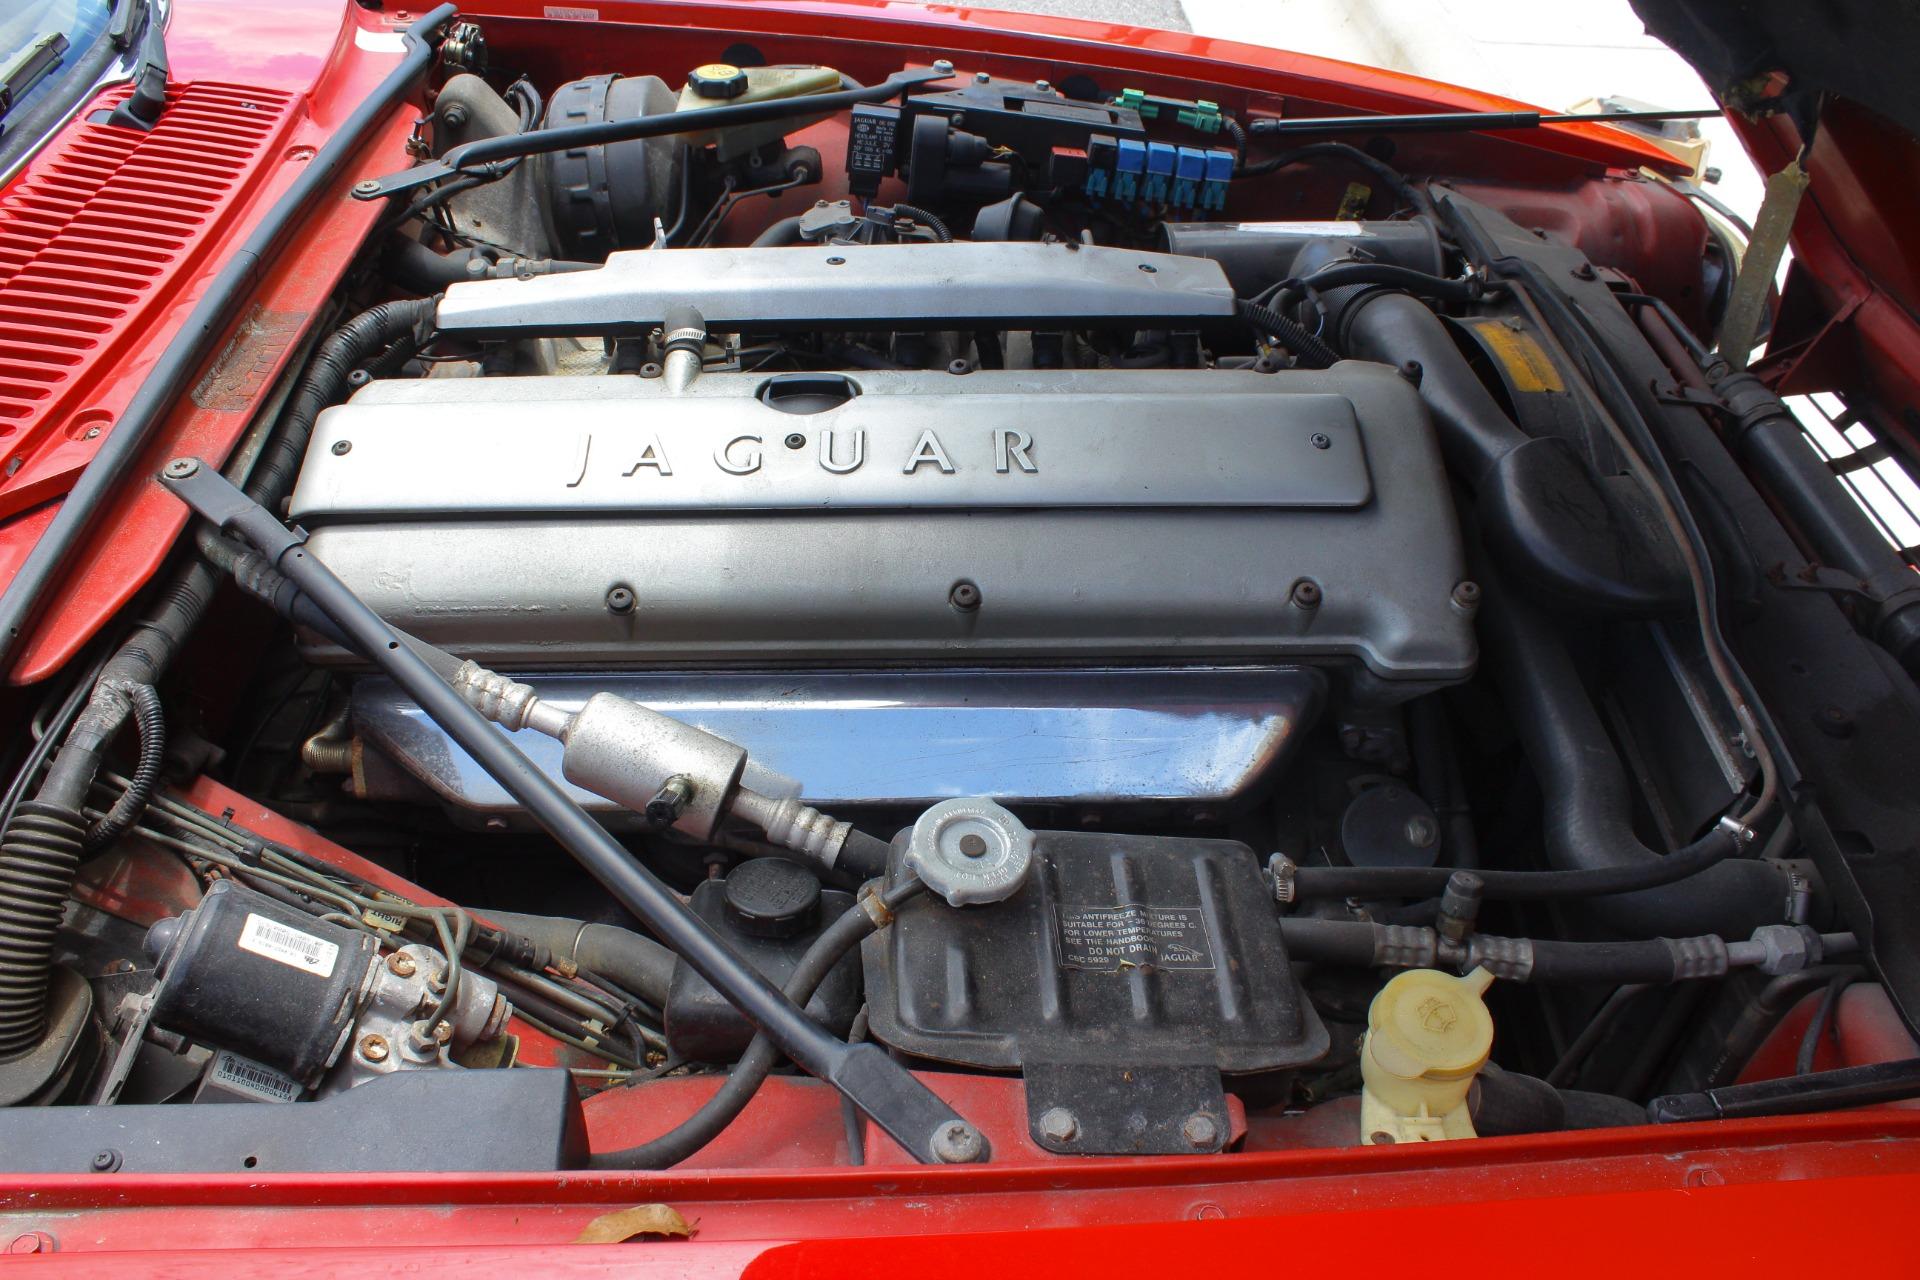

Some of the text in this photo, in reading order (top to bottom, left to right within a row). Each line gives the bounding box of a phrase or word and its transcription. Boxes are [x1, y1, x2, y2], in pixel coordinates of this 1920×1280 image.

[566, 427, 1038, 488] JAGUAR
[1082, 909, 1137, 920] ANTIFREEZE
[1062, 920, 1104, 928] SUITABLE
[1106, 920, 1125, 928] FOR
[1065, 936, 1083, 945] SEE
[1088, 943, 1158, 956] DO NOT DRAIN
[1160, 953, 1200, 962] JAGUAR
